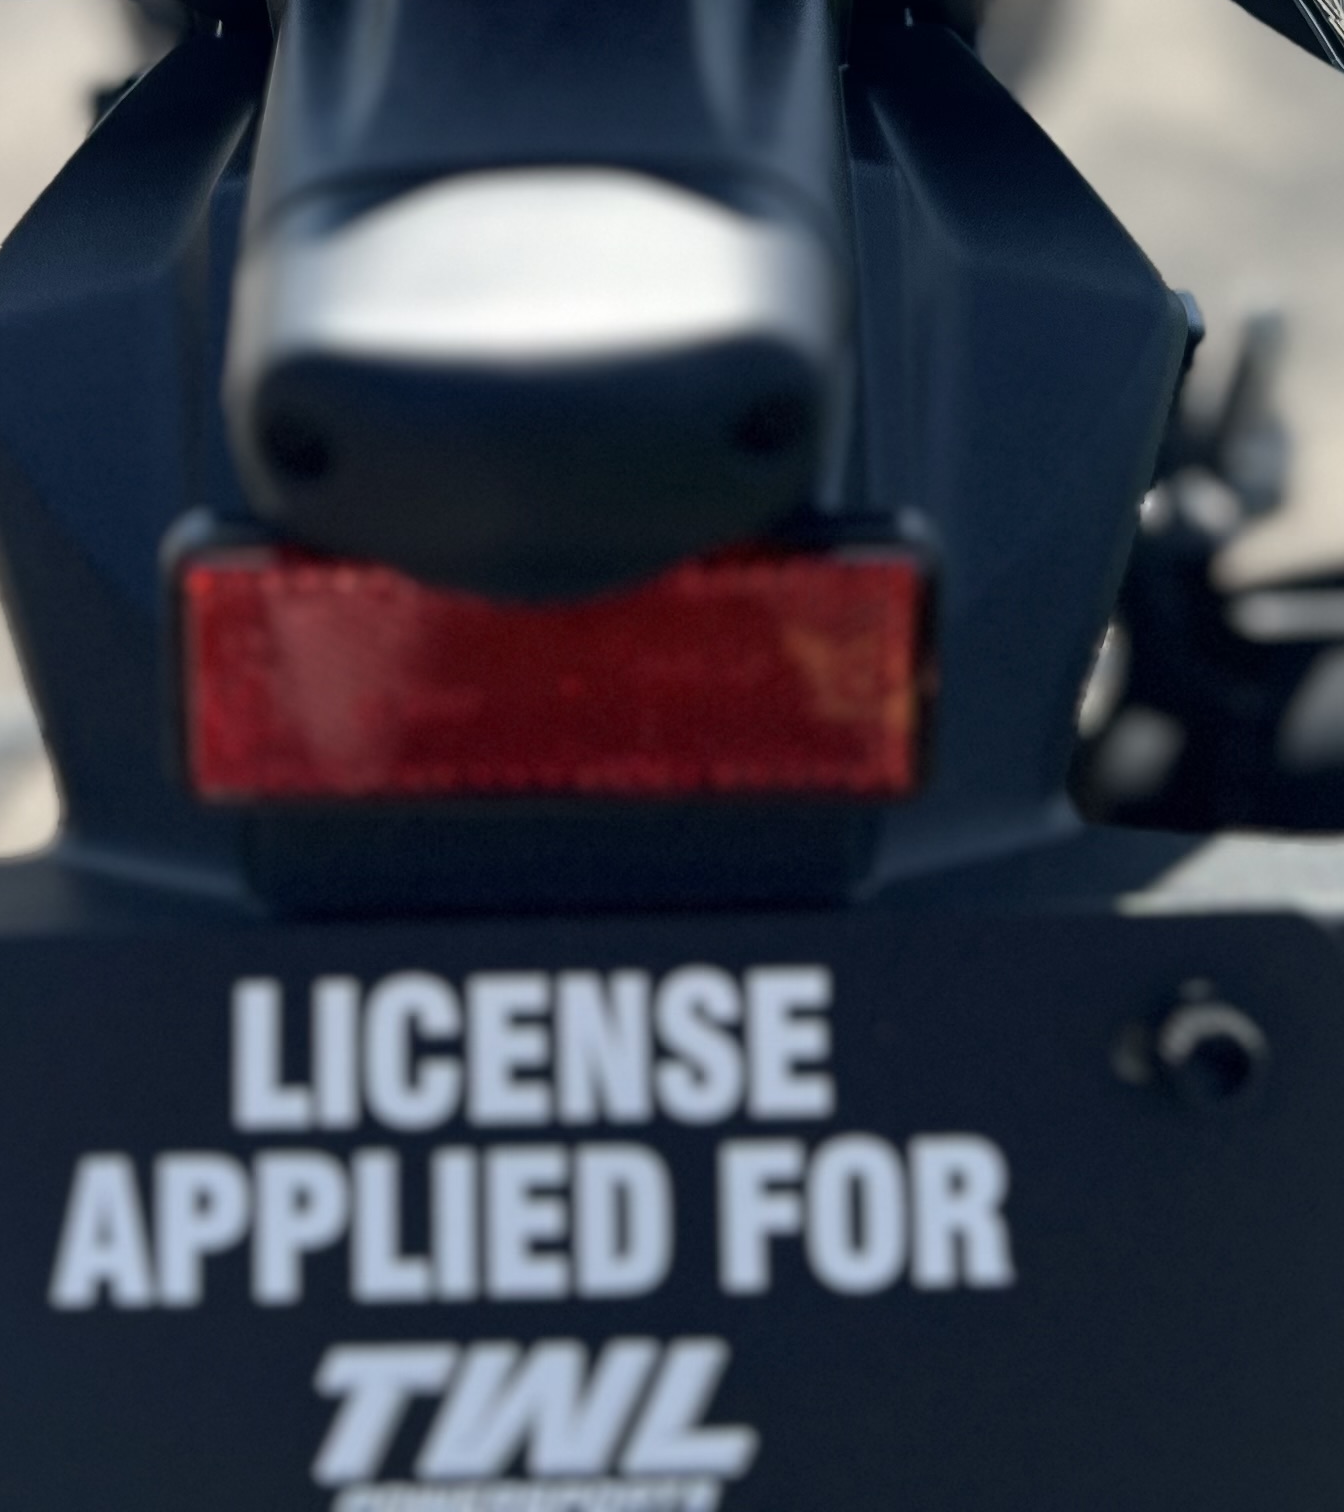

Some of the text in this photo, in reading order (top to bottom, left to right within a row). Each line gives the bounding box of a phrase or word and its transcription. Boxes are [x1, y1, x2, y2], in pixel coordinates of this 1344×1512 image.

[232, 966, 835, 1131] LICENSE
[49, 1135, 1013, 1309] APPLIED FOR
[311, 1337, 758, 1484] TWL
